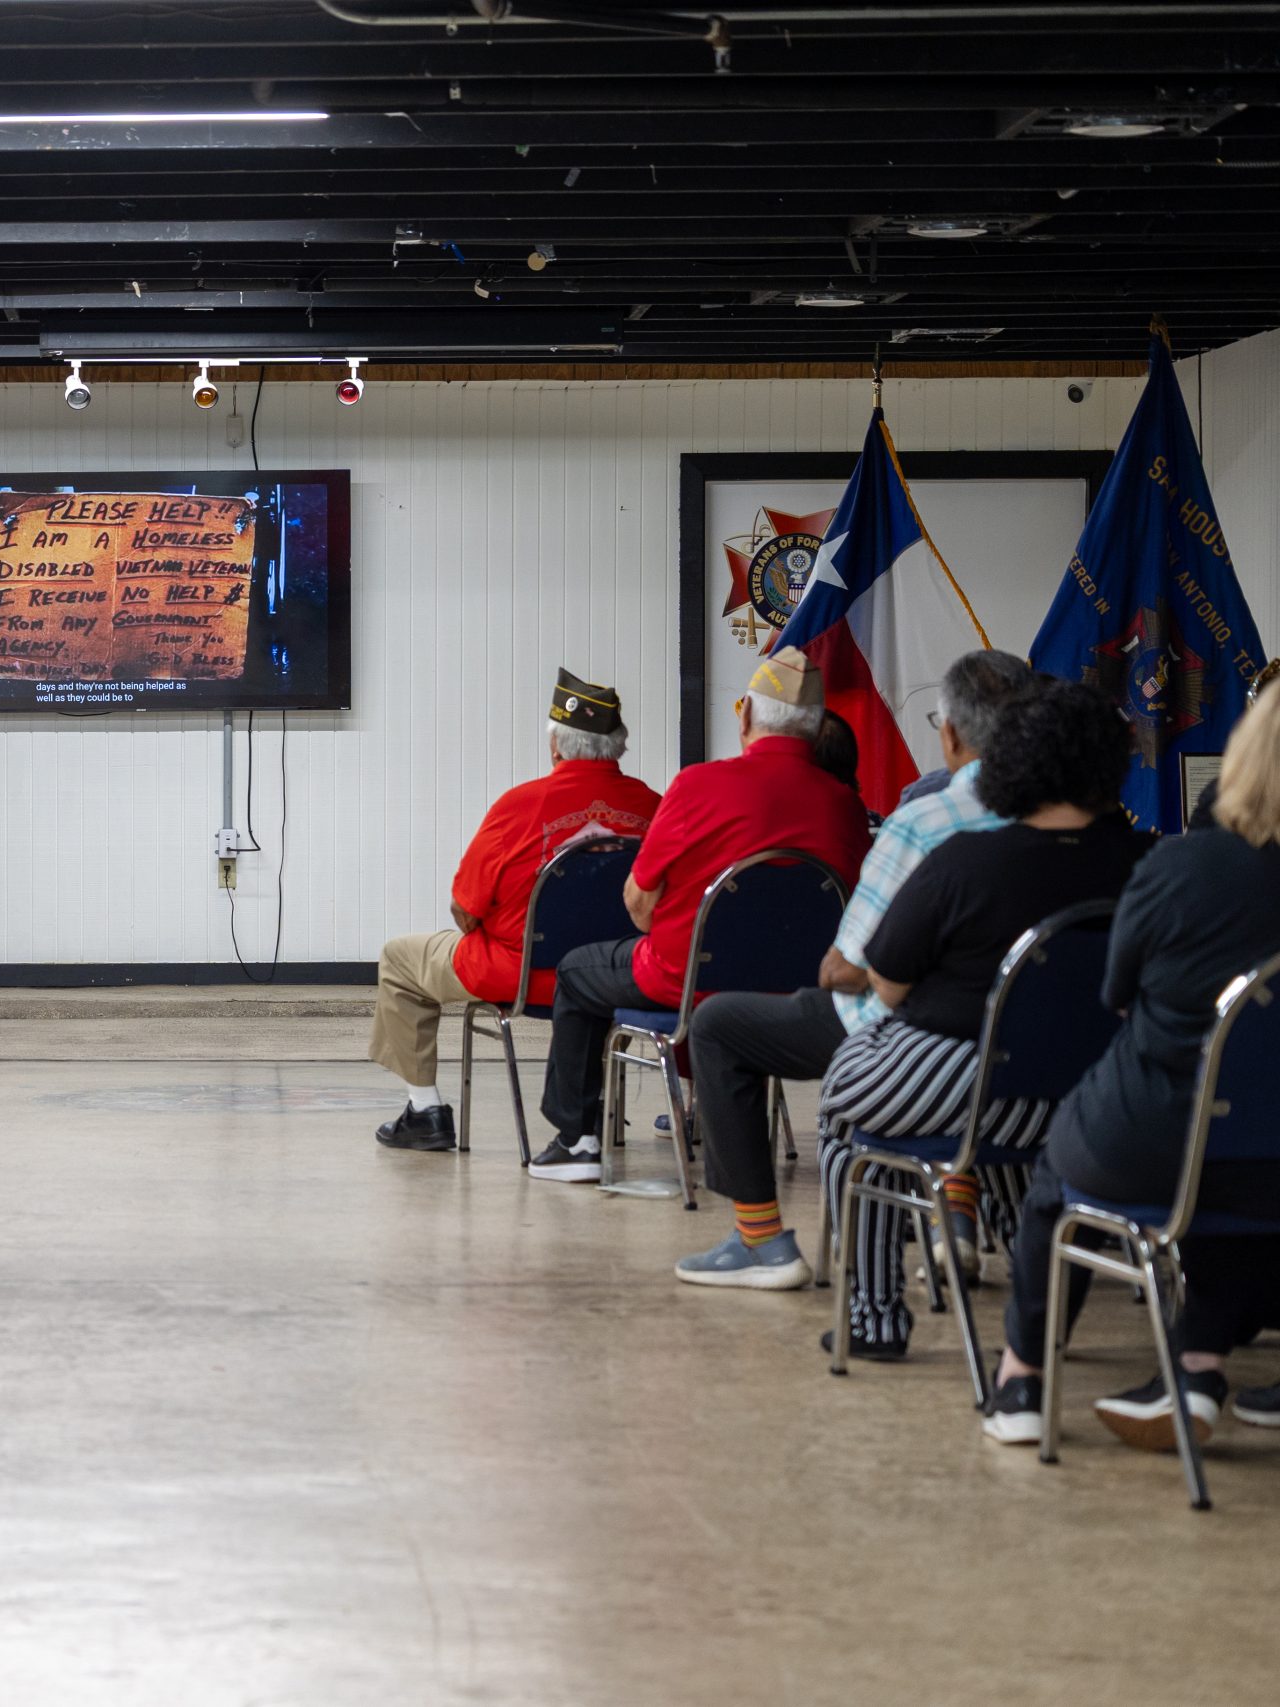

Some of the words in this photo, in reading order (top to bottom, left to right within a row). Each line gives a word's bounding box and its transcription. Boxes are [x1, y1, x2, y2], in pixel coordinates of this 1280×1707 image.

[46, 500, 138, 521] PLEASE
[32, 530, 68, 548] AM
[94, 532, 109, 550] A
[131, 527, 235, 549] HOMELESS
[1179, 498, 1232, 566] HOUS
[188, 560, 251, 576] VETERAN
[752, 544, 777, 604] VETERANS
[779, 537, 793, 548] OF
[29, 588, 107, 607] RECEIVE
[121, 586, 149, 602] NO
[165, 584, 214, 602] HELP
[1094, 597, 1111, 615] IN
[61, 616, 98, 637] ANY
[36, 682, 55, 691] days
[58, 682, 73, 690] and
[75, 682, 103, 691] they're
[105, 682, 119, 690] not
[120, 681, 143, 691] being
[146, 681, 174, 691] helped
[36, 693, 53, 702] well
[67, 693, 85, 703] they
[87, 693, 110, 702] could
[112, 693, 123, 702] be
